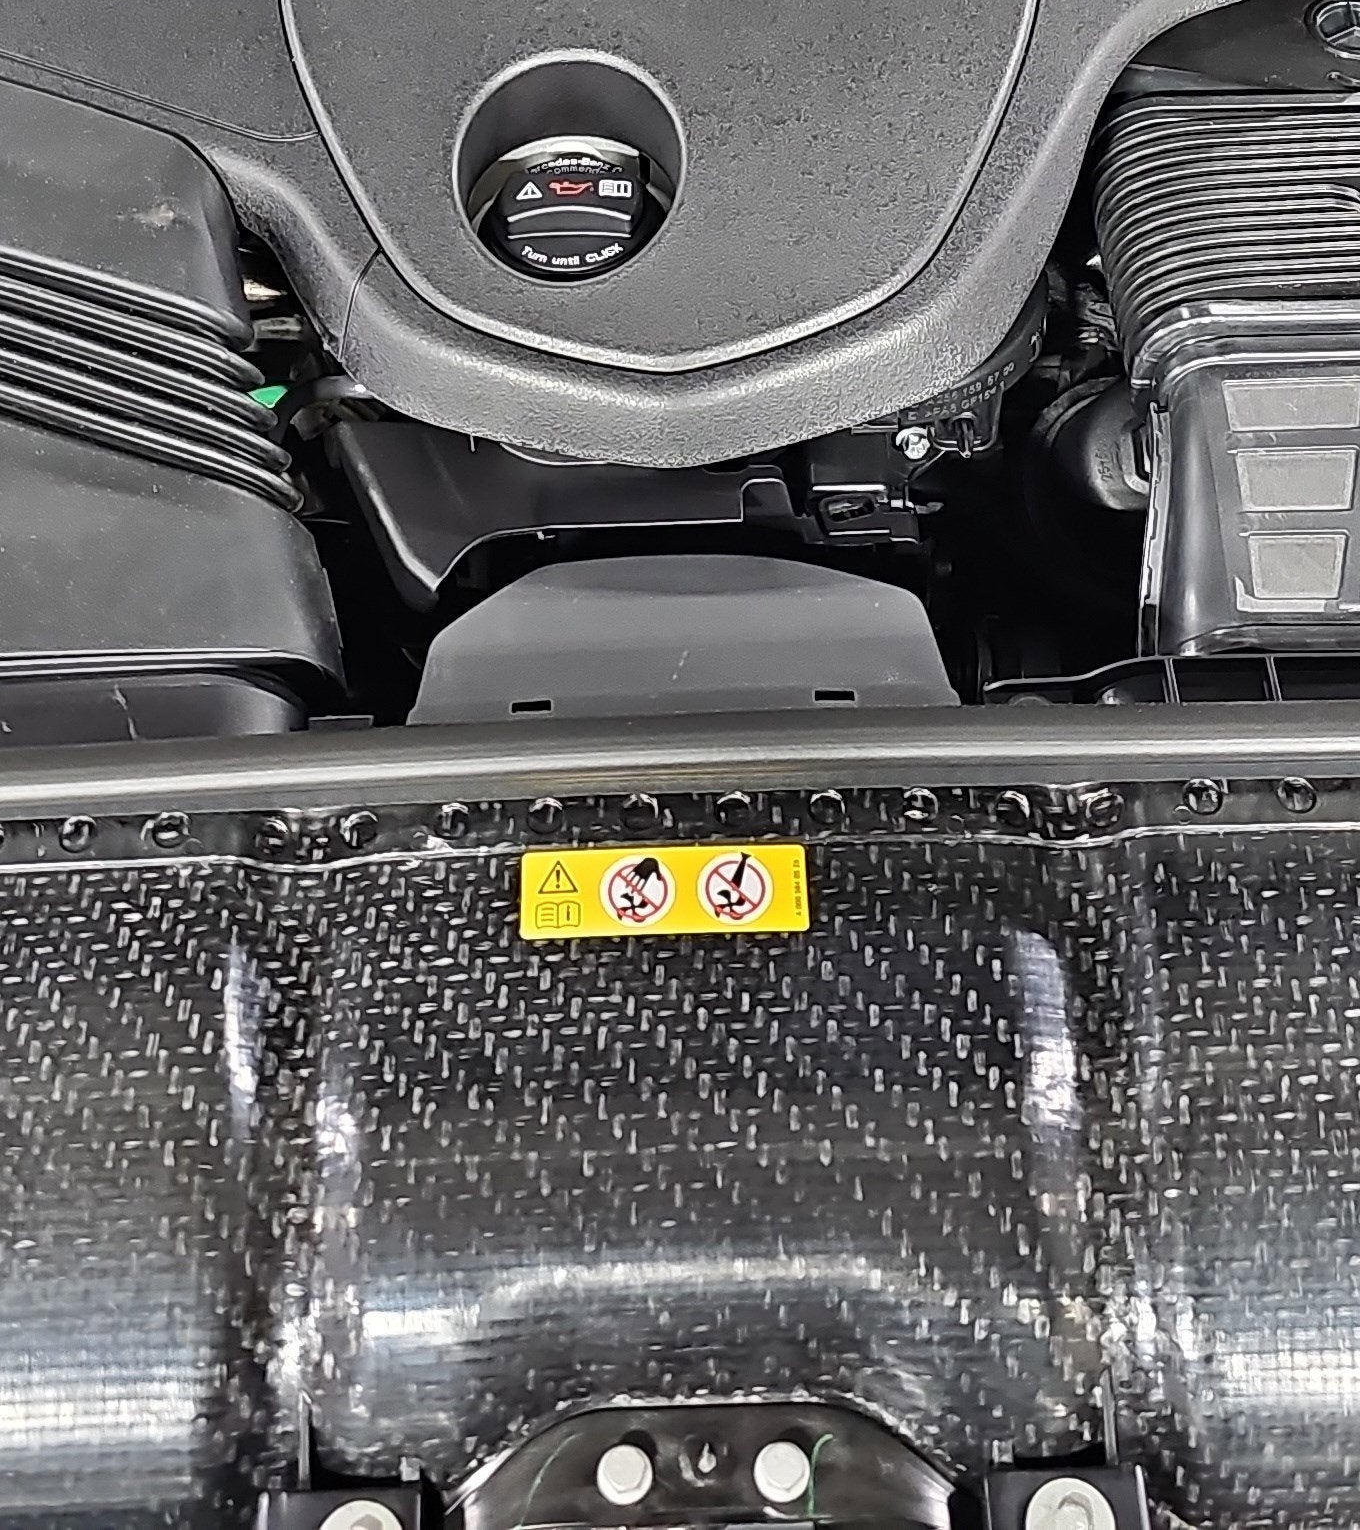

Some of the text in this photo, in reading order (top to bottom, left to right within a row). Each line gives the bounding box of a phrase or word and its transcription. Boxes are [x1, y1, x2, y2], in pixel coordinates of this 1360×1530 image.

[527, 158, 611, 174] ercedes-Benz
[522, 243, 623, 265] Turn until CLICK
